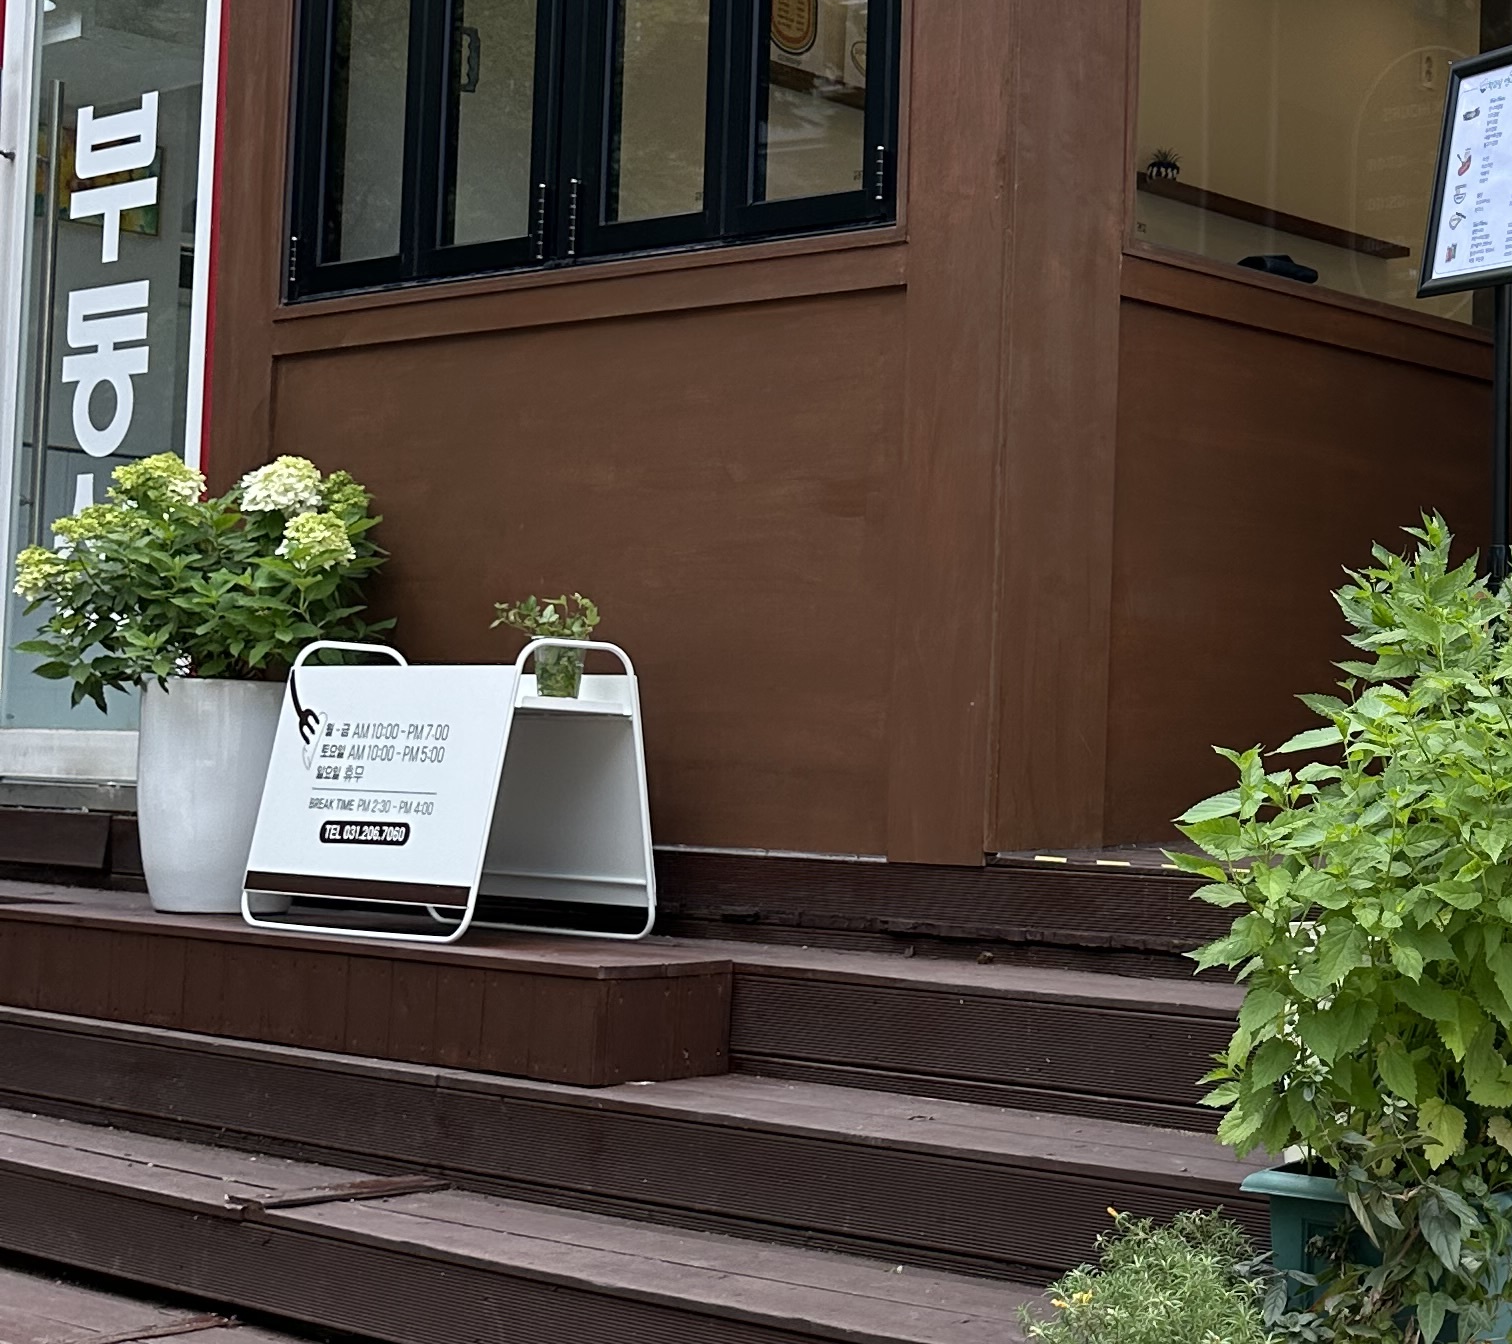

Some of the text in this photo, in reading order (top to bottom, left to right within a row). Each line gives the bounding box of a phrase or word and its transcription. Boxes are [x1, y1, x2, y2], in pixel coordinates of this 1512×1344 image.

[61, 90, 160, 518] 부동
[320, 744, 346, 759] 토요일
[316, 765, 365, 783] 일요일 휴무
[309, 797, 334, 811] BREAK
[336, 799, 355, 811] TIME
[325, 824, 341, 839] TEL
